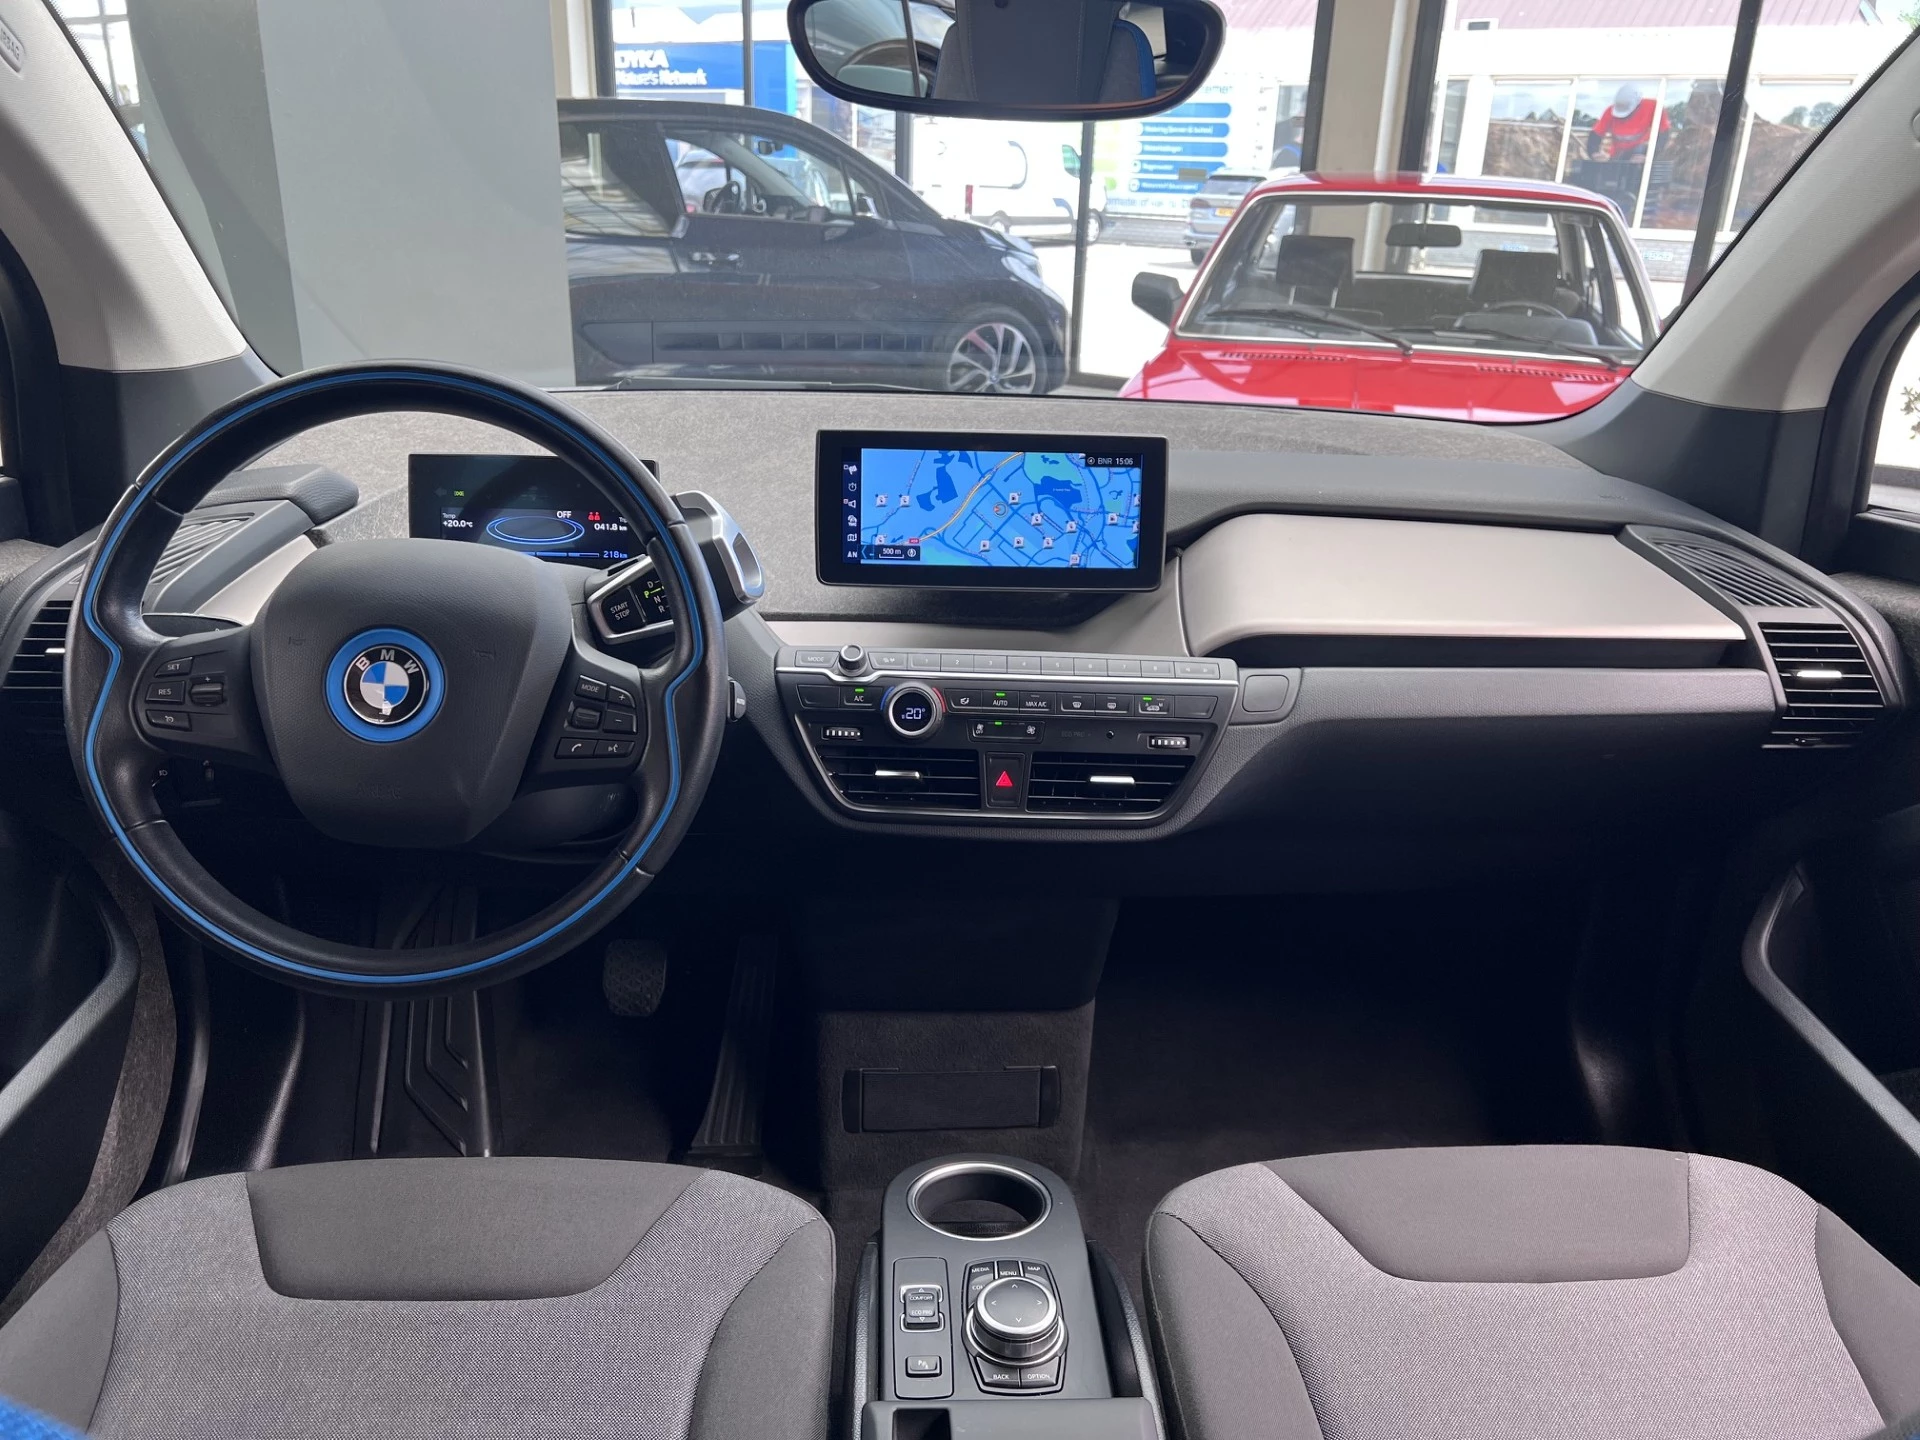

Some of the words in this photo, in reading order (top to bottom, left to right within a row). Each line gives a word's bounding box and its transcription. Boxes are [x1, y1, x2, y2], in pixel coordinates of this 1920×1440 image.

[1097, 457, 1112, 465] BNR
[1115, 457, 1134, 465] 15:06
[556, 510, 572, 518] OFF
[594, 523, 618, 531] 041.8
[653, 595, 661, 603] N
[610, 601, 628, 613] START
[615, 609, 630, 620] STOP
[355, 649, 420, 674] BMW
[167, 663, 180, 671] SET
[158, 688, 172, 696] RES
[581, 683, 600, 693] MODE
